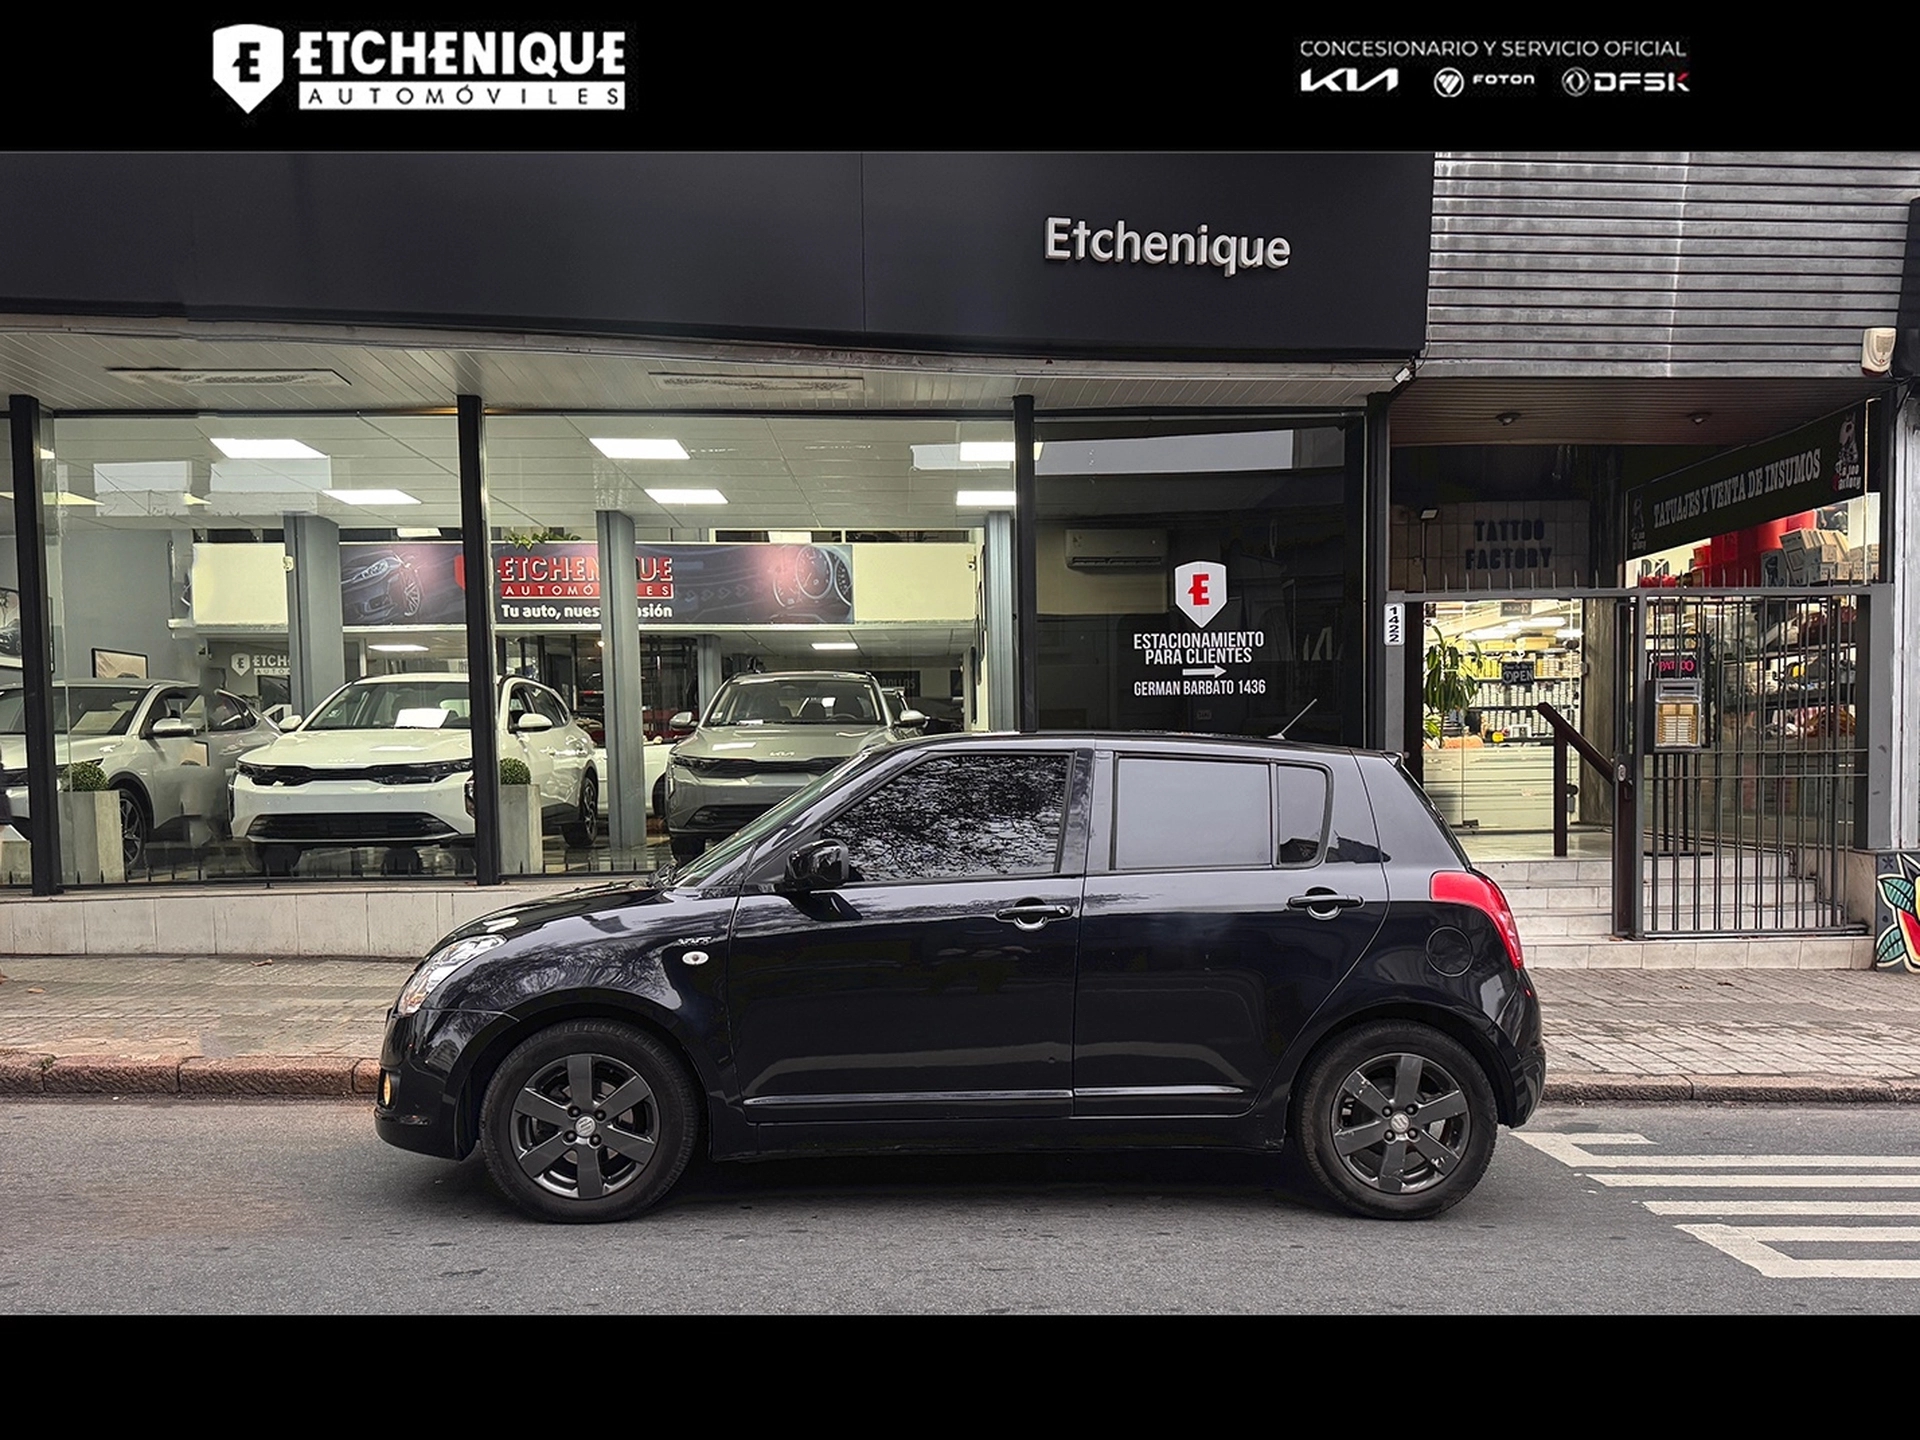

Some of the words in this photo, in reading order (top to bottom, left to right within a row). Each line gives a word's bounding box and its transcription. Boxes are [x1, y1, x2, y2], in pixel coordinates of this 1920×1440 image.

[1045, 216, 1291, 277] Etchenique
[1653, 489, 1700, 529] TATUAJES
[1701, 486, 1710, 513] Y
[1709, 473, 1746, 510] VENTA
[1748, 467, 1763, 498] DE
[1764, 448, 1821, 493] INSUMOS
[1474, 519, 1545, 541] TATTOO
[1465, 547, 1552, 570] FACTORY
[1188, 574, 1210, 605] E
[501, 604, 519, 618] Tu
[522, 604, 561, 620] auto,
[1389, 606, 1400, 643] 1422
[1133, 631, 1265, 650] ESTACIONAMIENTO
[252, 654, 291, 667] ETCH
[1145, 649, 1183, 665] PARA
[1186, 647, 1252, 664] CLIENTES
[1502, 669, 1534, 684] OPEN
[1134, 681, 1181, 697] GERMAN
[1183, 680, 1234, 696] BARBATO
[1238, 679, 1266, 694] 1436
